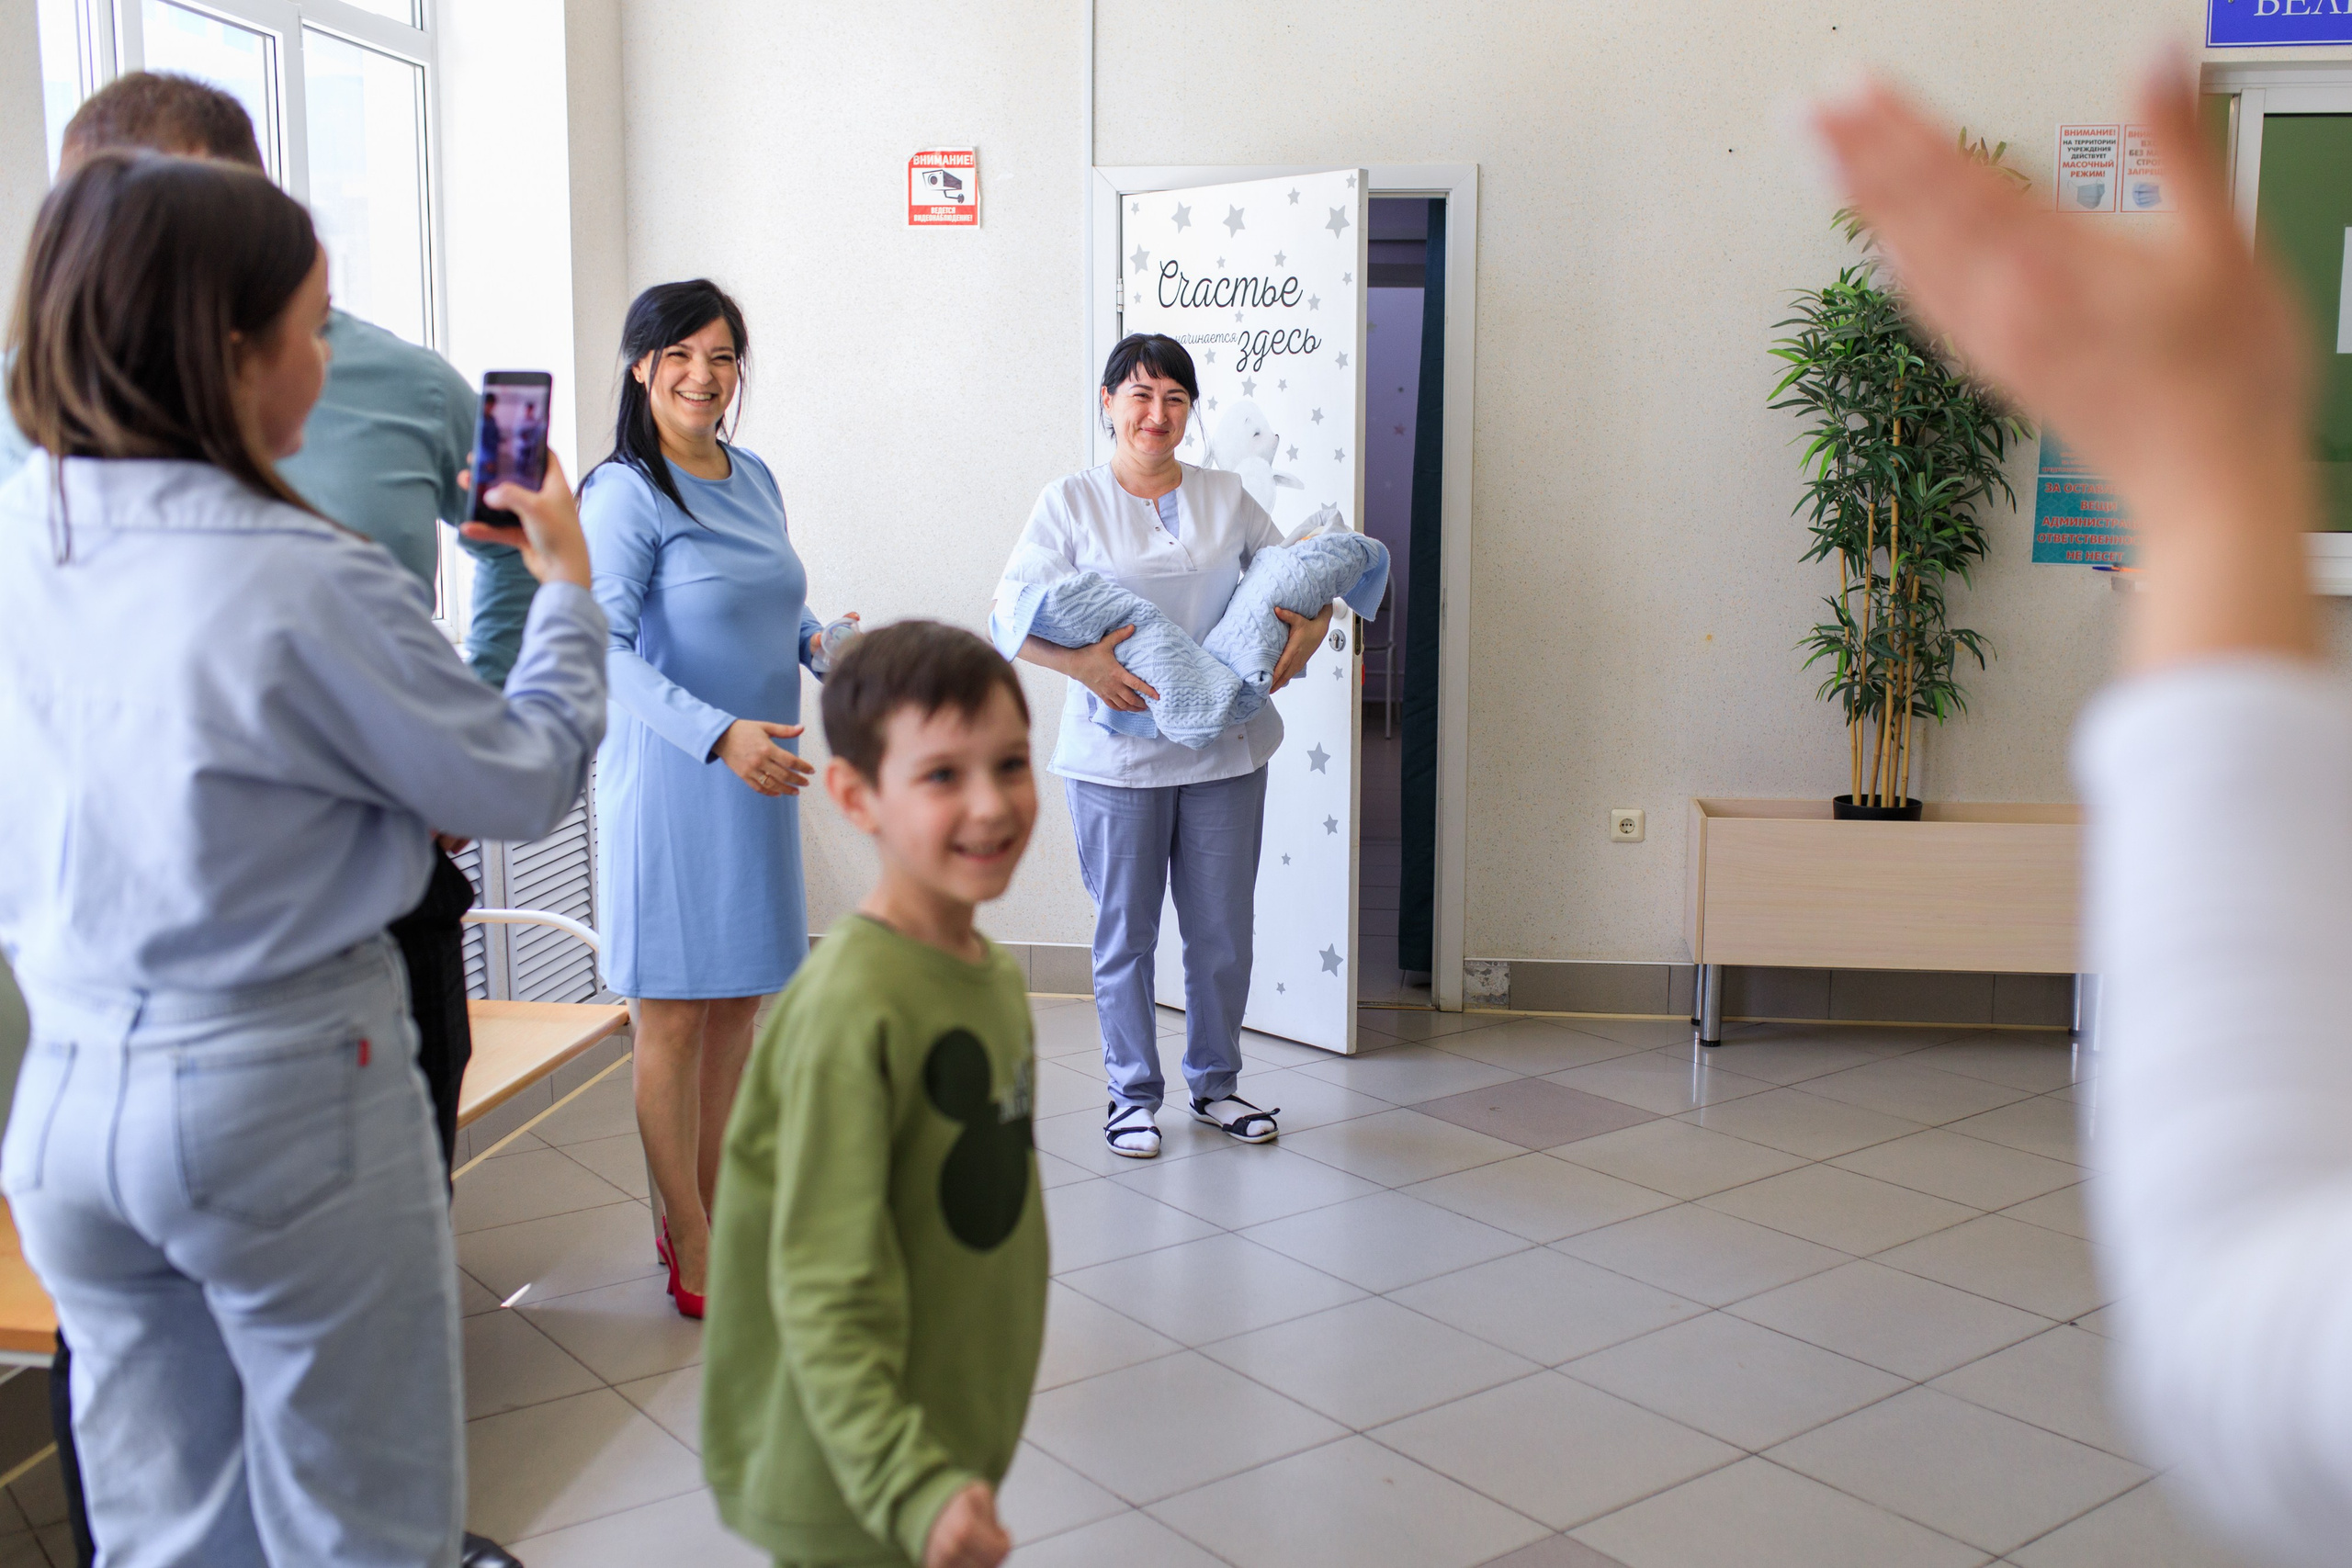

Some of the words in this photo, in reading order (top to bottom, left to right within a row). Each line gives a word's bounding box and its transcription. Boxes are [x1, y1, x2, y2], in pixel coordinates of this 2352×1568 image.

[2064, 129, 2116, 137] ВНИМАНИЕ!
[912, 154, 974, 165] ВНИМАНИЕ!
[2063, 160, 2114, 168] МАСОЧНЫЙ
[913, 214, 973, 222] ВИДЕОНАБЛЮДЕНИЕ!
[1159, 260, 1303, 308] Счастье
[1237, 328, 1321, 372] здесь
[2044, 483, 2061, 492] ЗА
[2080, 501, 2117, 512] ВЕЩИ
[2042, 517, 2143, 529] АДМИНИСТРАЦИ
[2066, 551, 2082, 560] НЕ
[2086, 551, 2123, 561] НЕСЕТ
